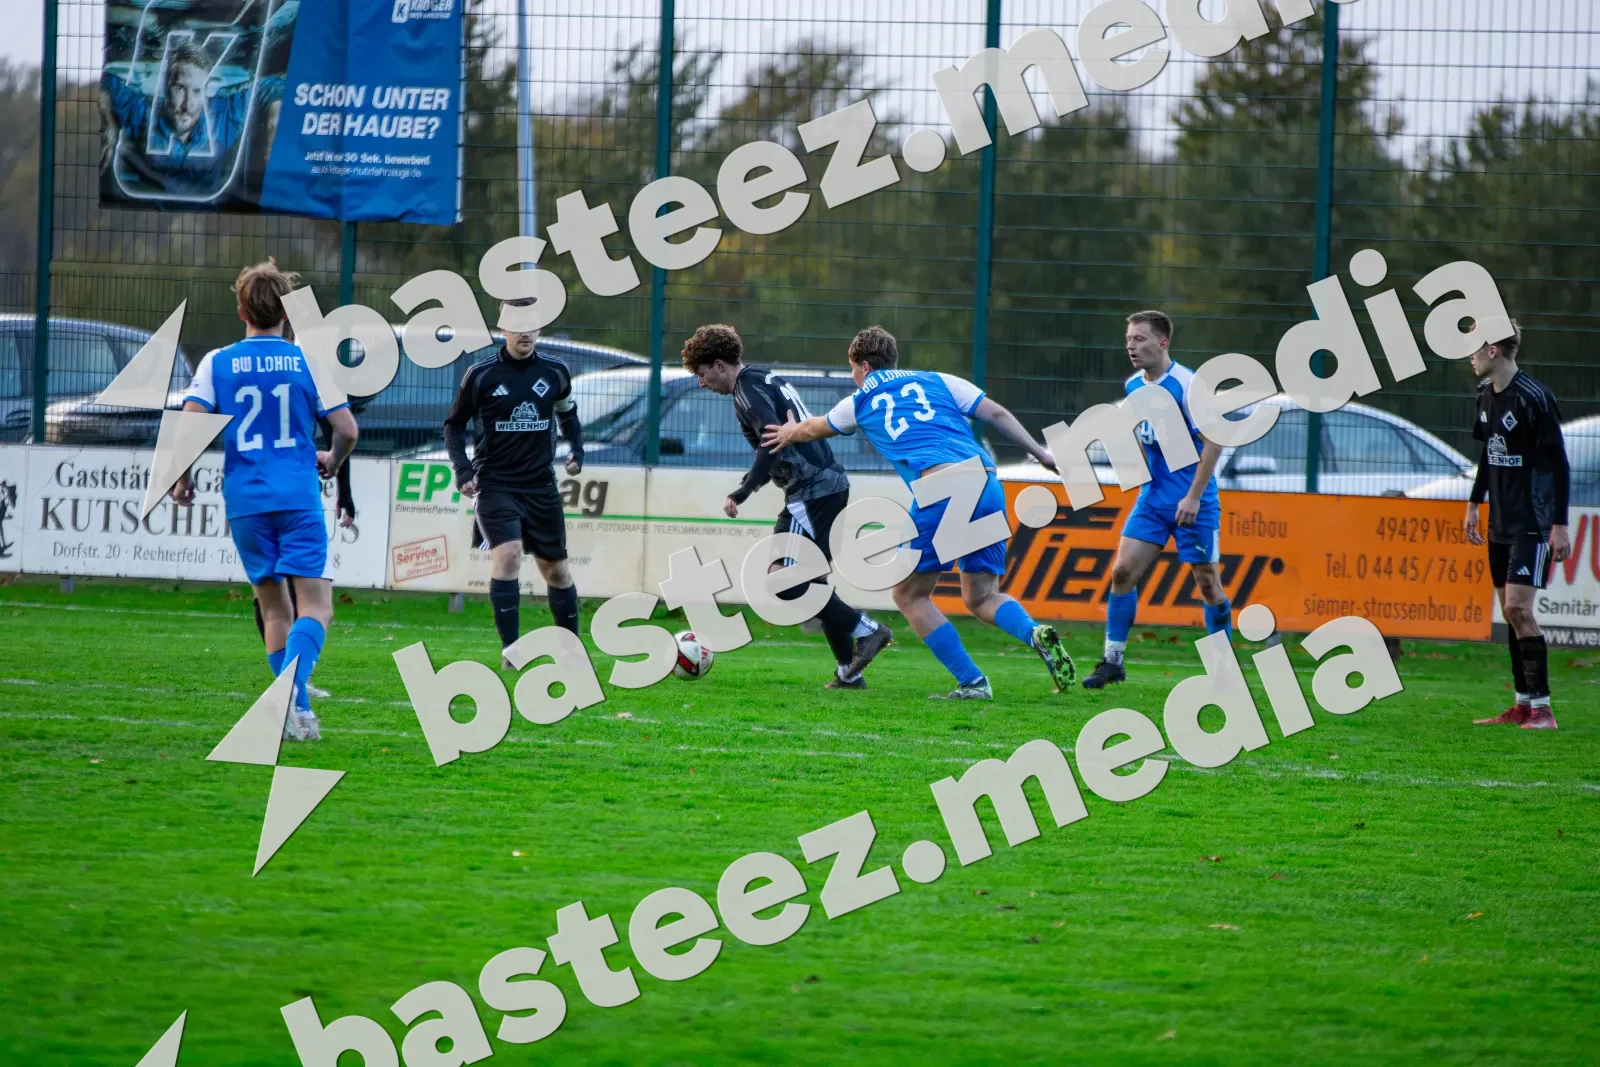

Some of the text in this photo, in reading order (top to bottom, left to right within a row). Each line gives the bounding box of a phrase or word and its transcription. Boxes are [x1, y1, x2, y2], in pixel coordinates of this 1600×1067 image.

[294, 83, 450, 110] SCHON UNTER
[301, 112, 440, 139] DER HAUBE?
[344, 153, 358, 162] 30
[231, 358, 252, 373] BW
[235, 383, 296, 451] 21
[871, 382, 936, 441] 23
[496, 421, 549, 431] WIESENHOF
[395, 504, 459, 515] ElectronicPartner
[1228, 512, 1288, 538] Tiefbau
[1376, 517, 1430, 543] 49429
[52, 541, 100, 559] Dorfstr.
[104, 544, 121, 560] 20
[132, 546, 206, 564] Rechterfeld
[396, 548, 437, 565] Service
[1325, 552, 1351, 580] Tel.
[1464, 559, 1485, 585] 49
[1303, 593, 1483, 625] siemer-strassenbau.de
[1538, 597, 1599, 617] Sanitär
